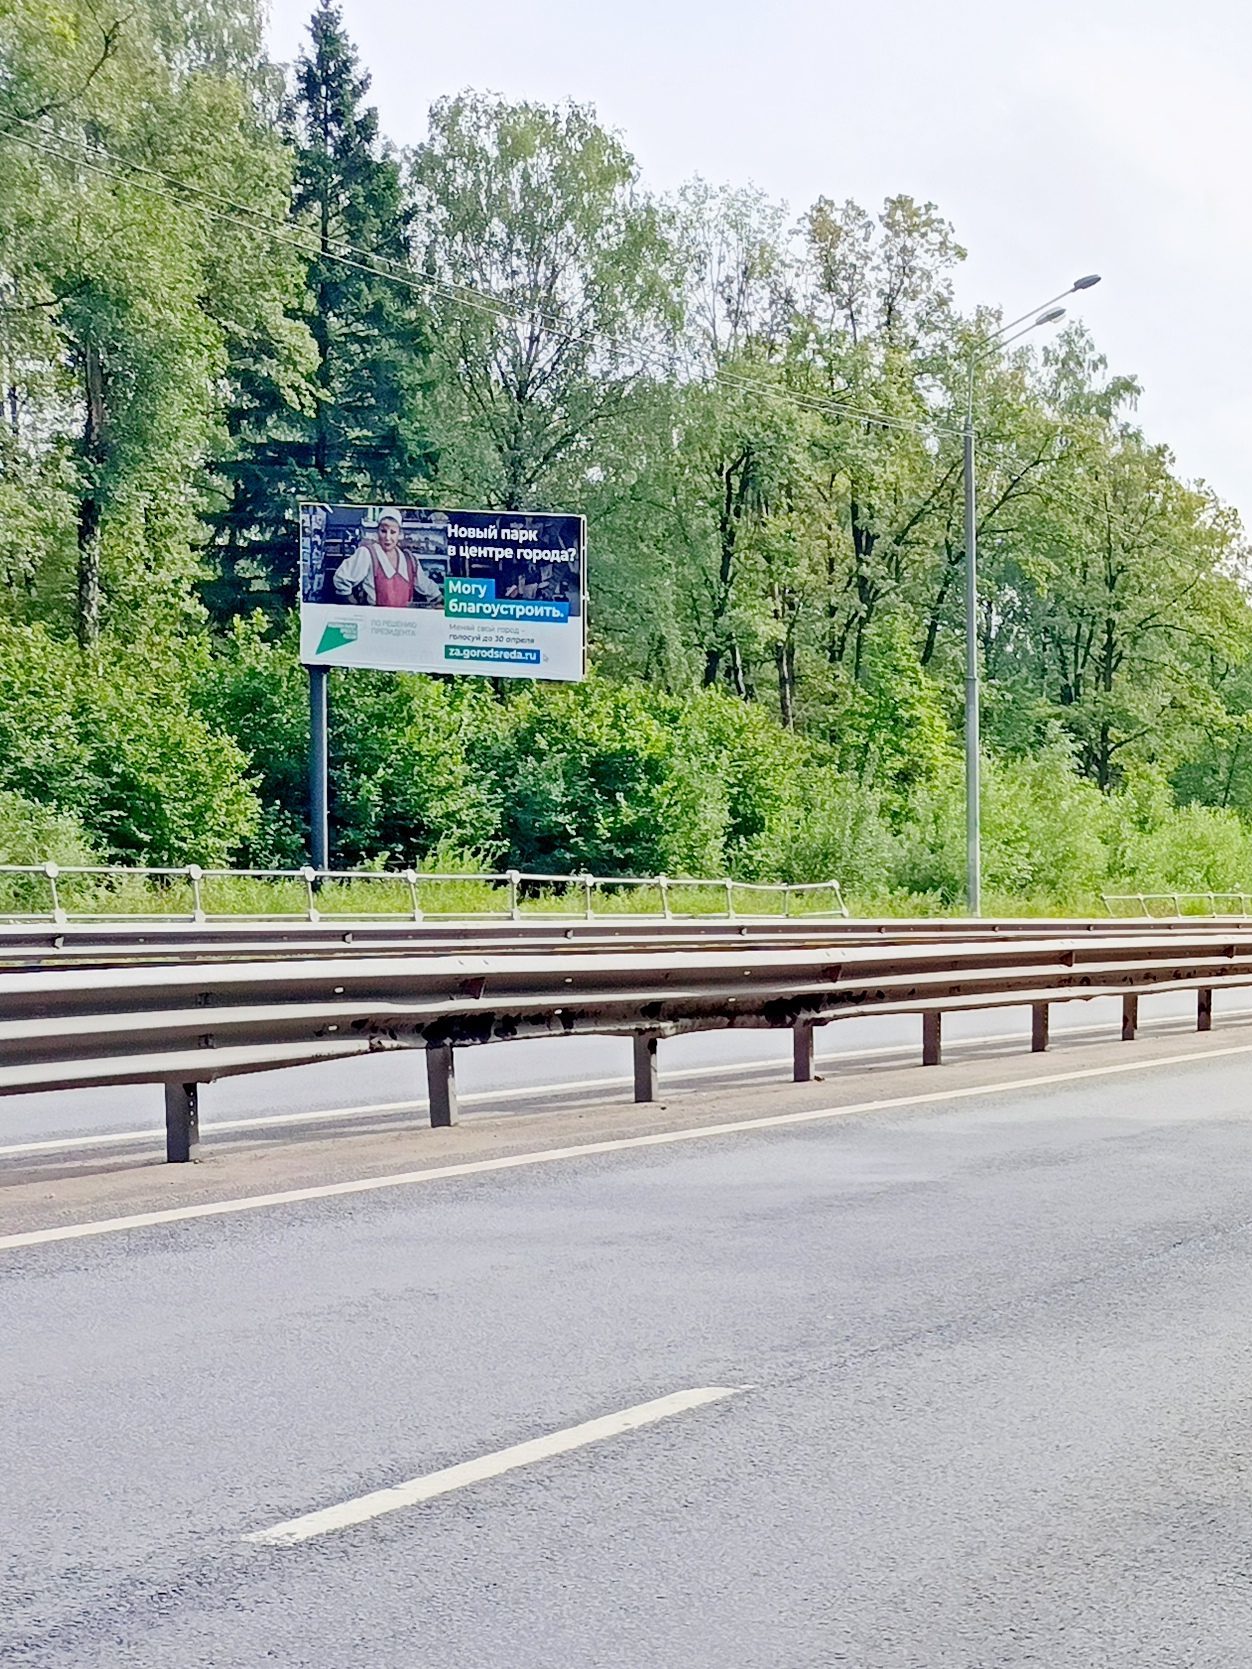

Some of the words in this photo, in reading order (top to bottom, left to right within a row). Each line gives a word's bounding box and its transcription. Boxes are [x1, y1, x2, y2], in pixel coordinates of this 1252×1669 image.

[447, 524, 498, 540] Новый
[501, 528, 538, 544] парк
[447, 545, 456, 556] в
[459, 545, 514, 561] центре
[516, 548, 577, 563] города?
[448, 580, 487, 598] Могу
[448, 599, 564, 618] благоустроить.
[449, 633, 481, 643] голосуй
[506, 637, 535, 645] апреля
[448, 647, 537, 661] za.gorodsreda.ru
